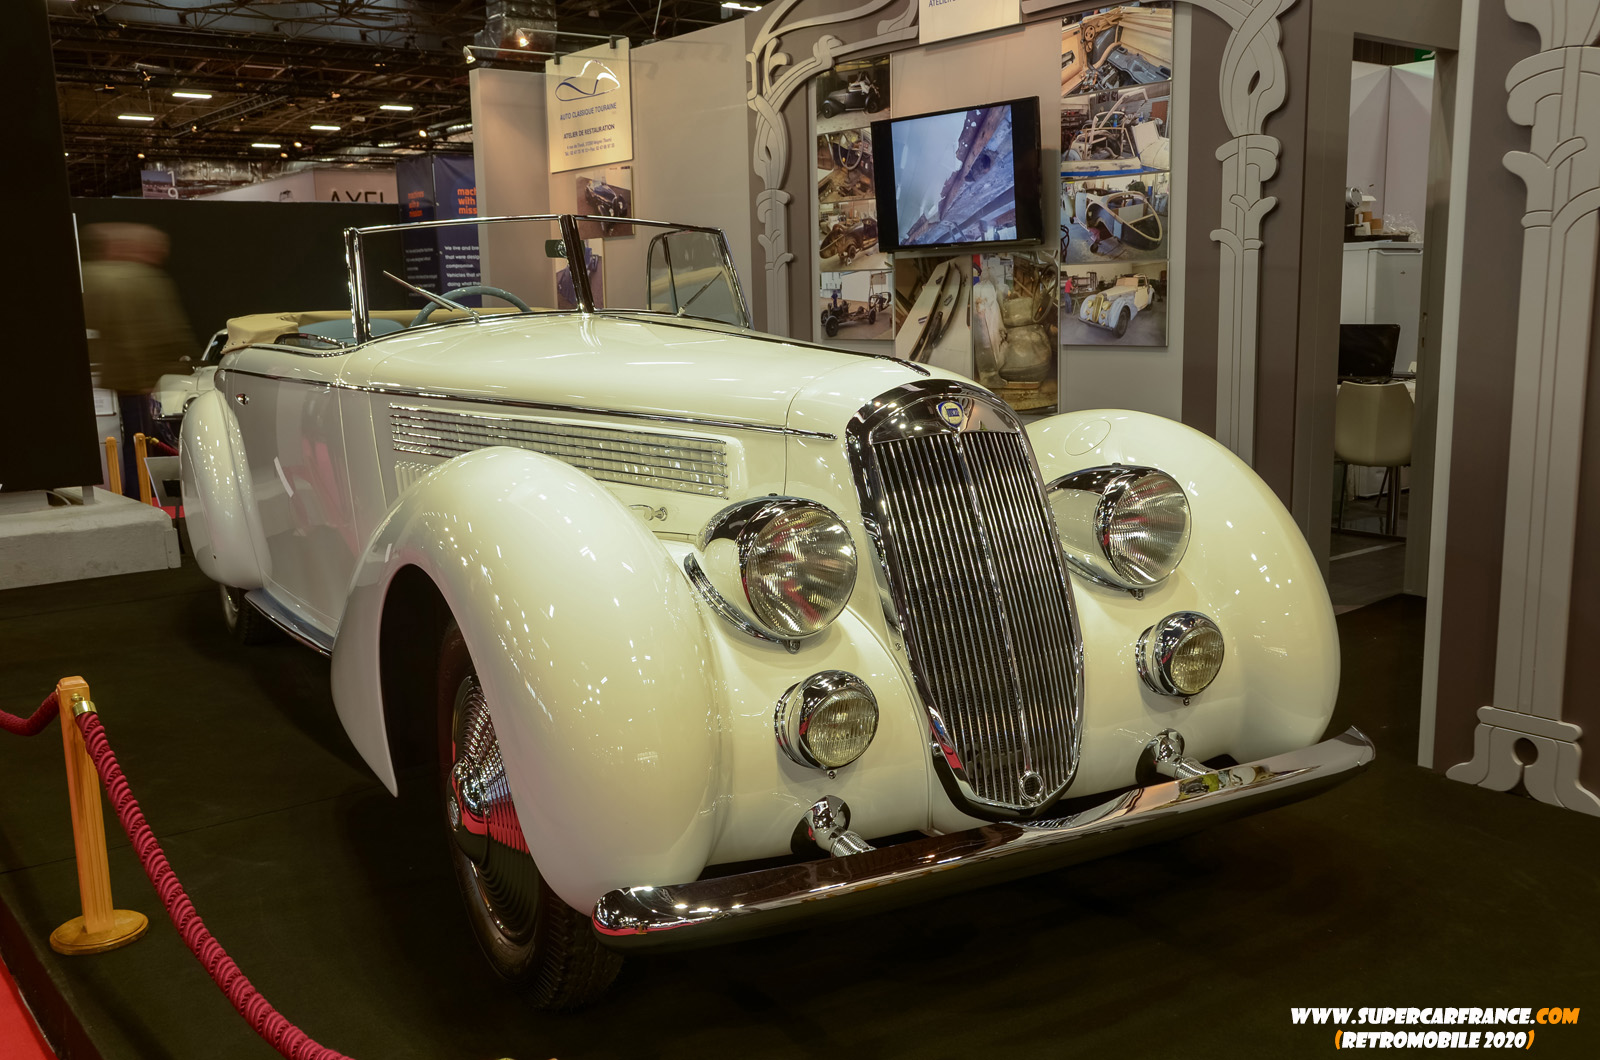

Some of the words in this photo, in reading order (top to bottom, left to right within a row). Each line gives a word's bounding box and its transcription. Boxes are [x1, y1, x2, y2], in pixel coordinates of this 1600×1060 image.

[560, 112, 571, 120] AUTO
[572, 107, 594, 118] CLASSIQUE
[595, 102, 617, 112] TOURAINE
[564, 131, 578, 139] ATELIER
[585, 124, 615, 136] RESTAURATION
[458, 196, 475, 205] with
